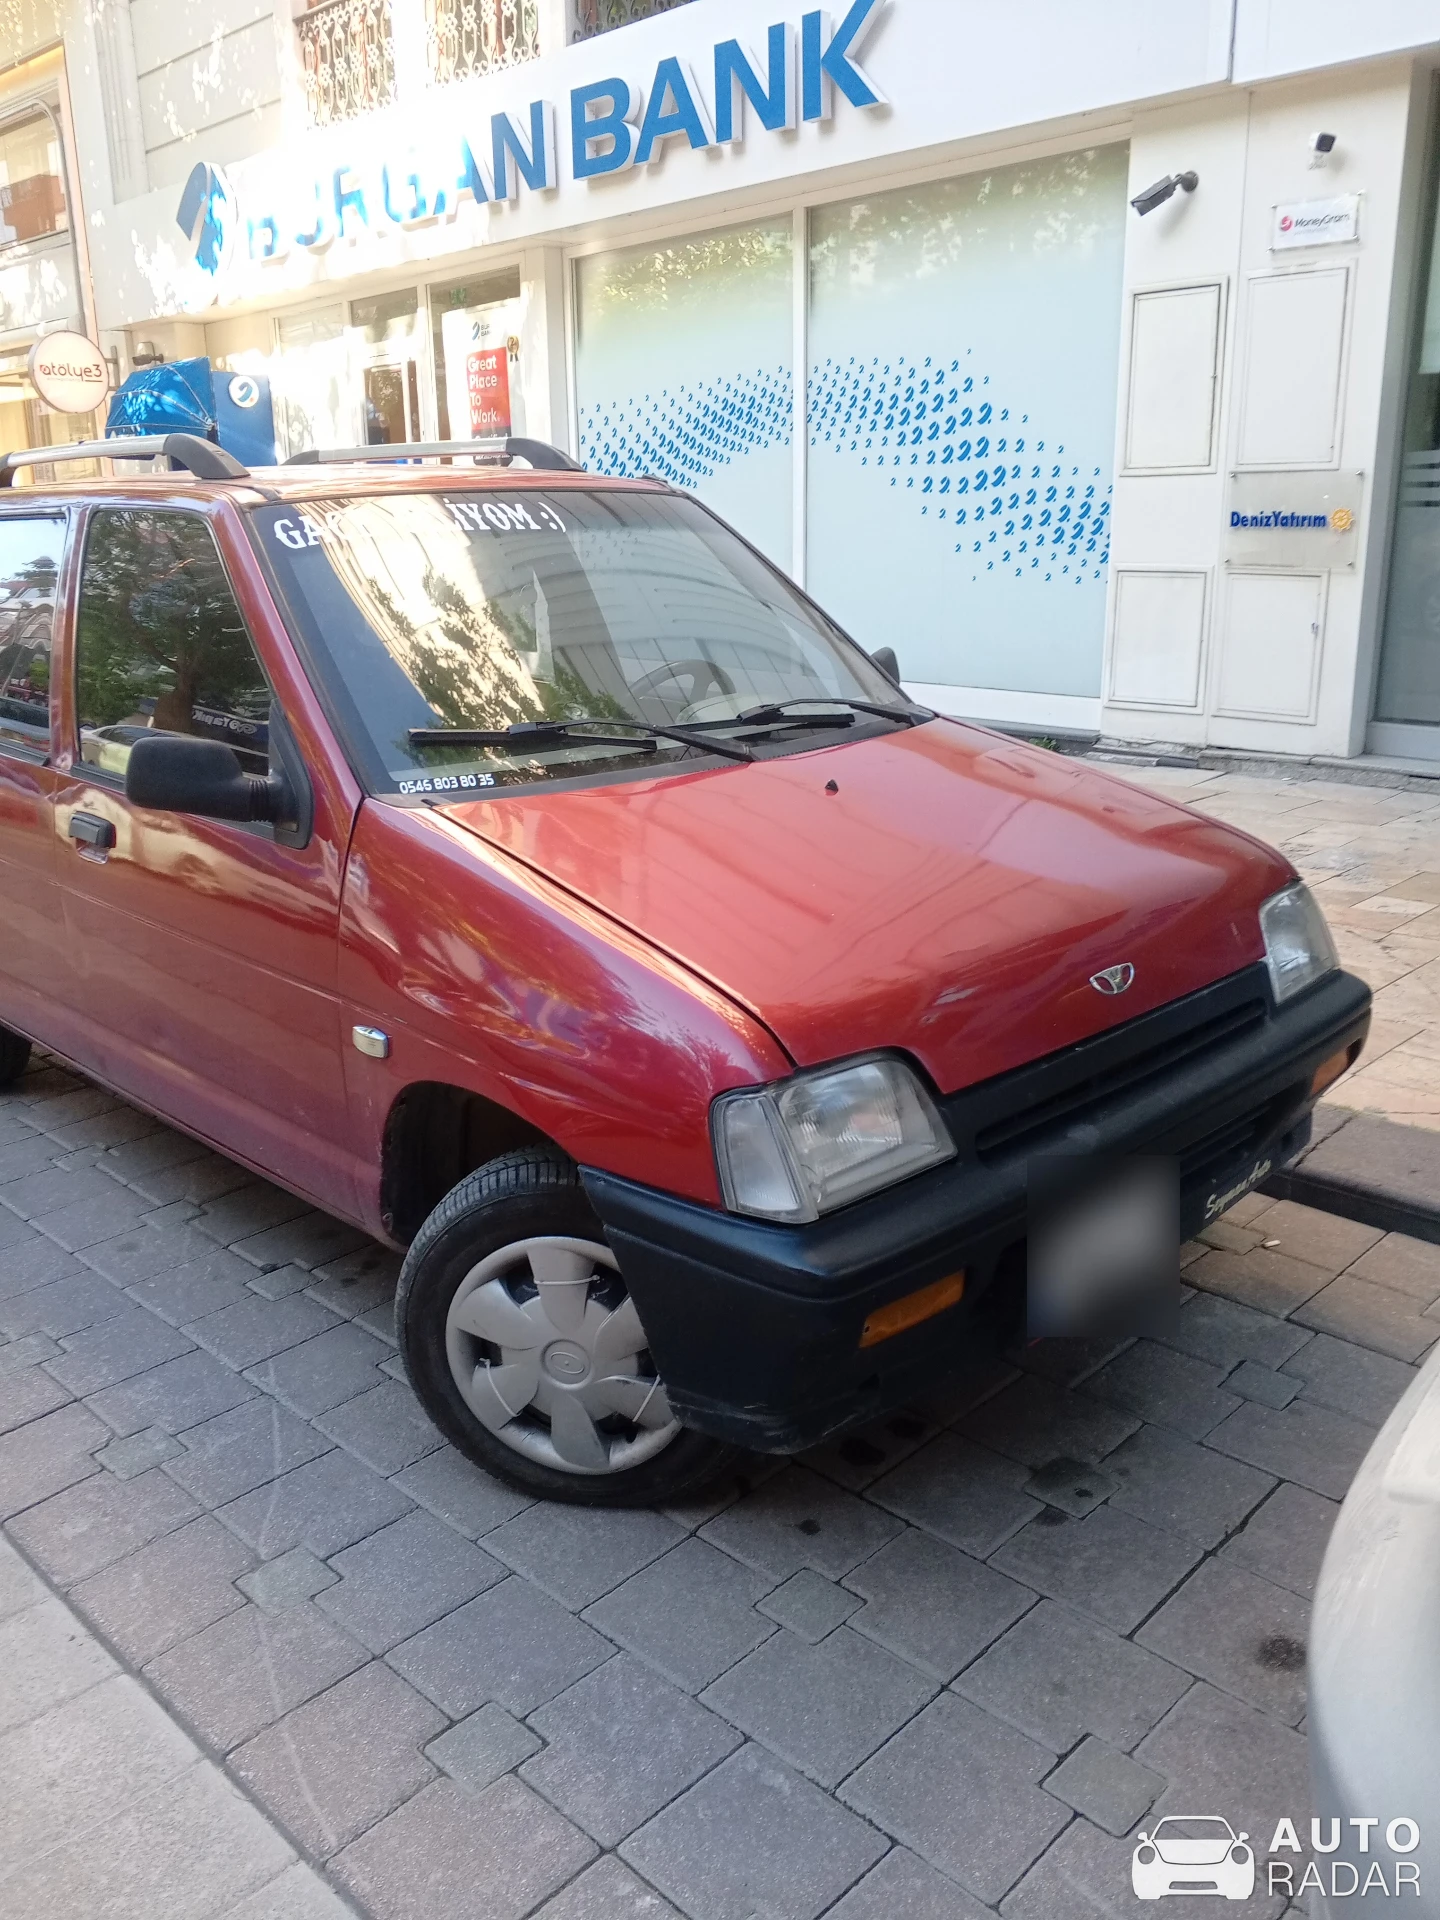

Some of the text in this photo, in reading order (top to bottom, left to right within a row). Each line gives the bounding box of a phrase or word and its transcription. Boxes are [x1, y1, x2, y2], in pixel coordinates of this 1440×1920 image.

[570, 0, 889, 179] BANK
[40, 362, 102, 381] atölye3
[468, 355, 497, 372] Great
[470, 375, 497, 389] Place
[470, 392, 481, 406] To
[1230, 511, 1327, 528] DenizYatırım
[434, 776, 459, 790] 803
[459, 774, 477, 787] 80
[477, 773, 495, 786] 35
